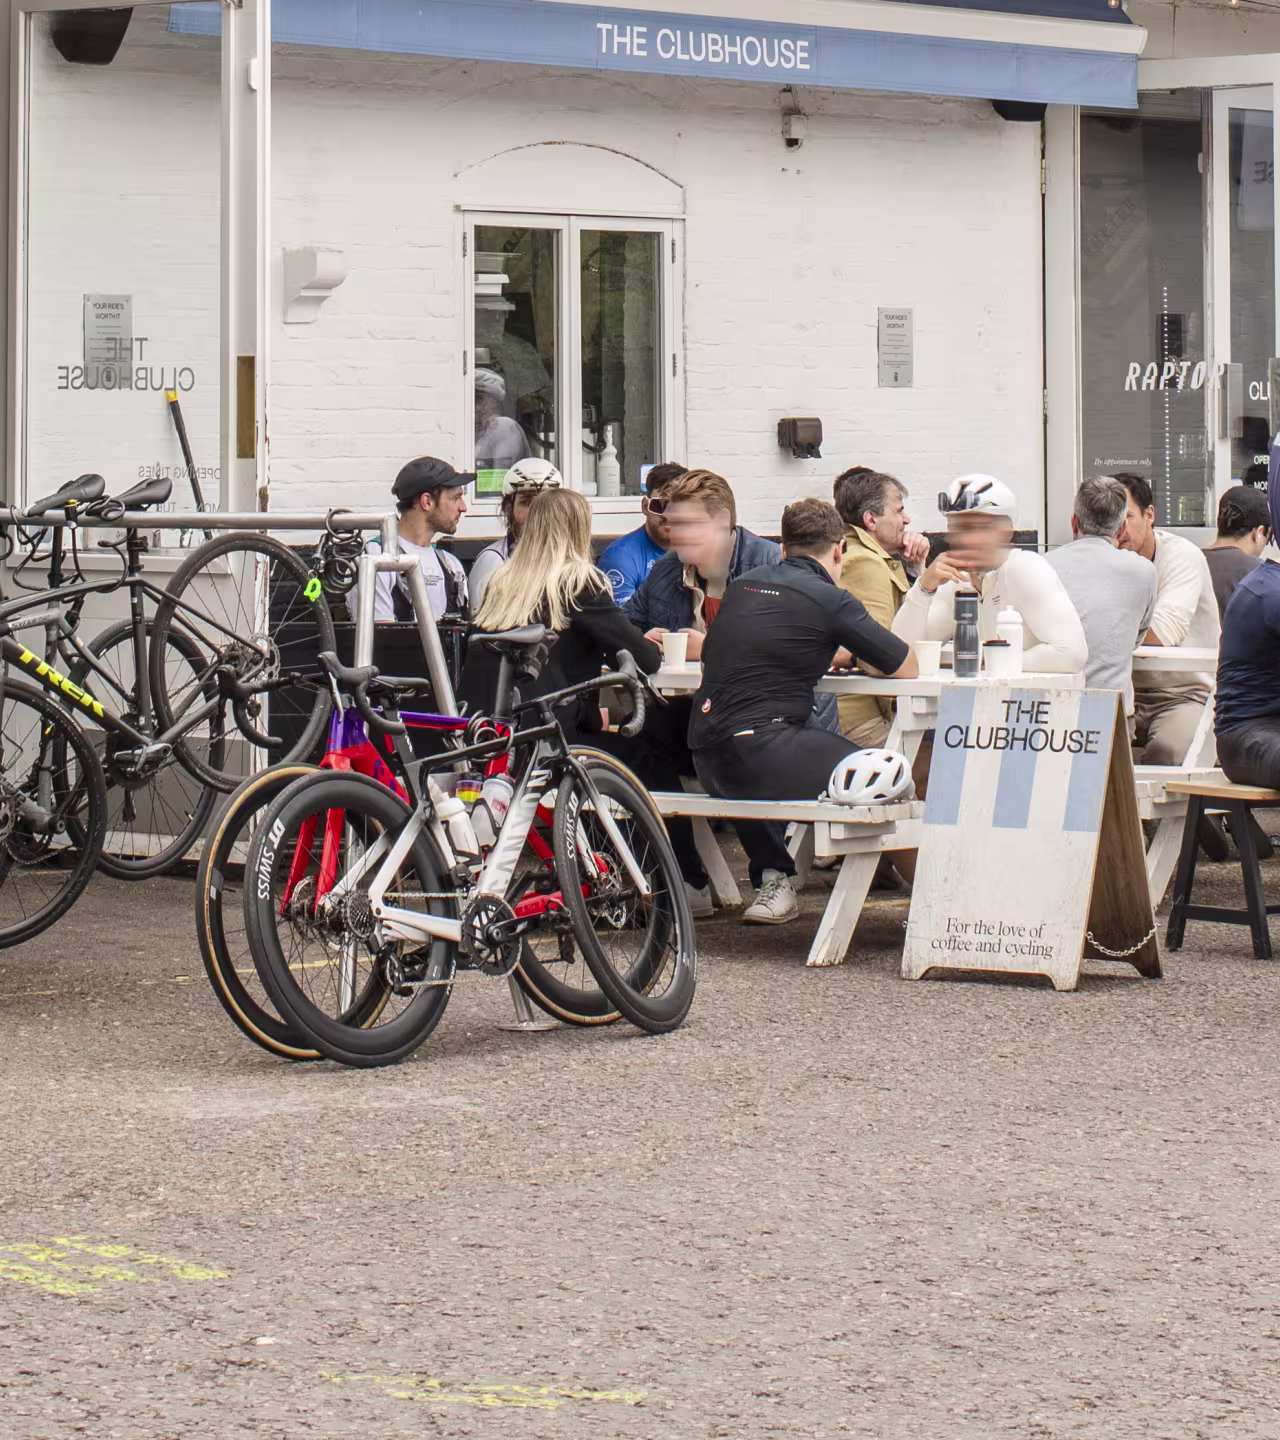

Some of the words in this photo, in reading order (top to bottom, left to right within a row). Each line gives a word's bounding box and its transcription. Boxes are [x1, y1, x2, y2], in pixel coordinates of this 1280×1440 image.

[597, 23, 648, 56] THE
[656, 28, 811, 69] CLUBHOUSE
[16, 643, 105, 717] TREK
[1002, 700, 1051, 724] THE
[944, 725, 1101, 754] CLUBHOUSE
[268, 817, 286, 849] DT
[566, 814, 576, 861] SWISS
[257, 846, 275, 900] SWISS
[946, 917, 971, 934] For
[974, 919, 995, 936] the
[998, 920, 1025, 938] love
[1029, 922, 1047, 939] of
[931, 934, 973, 952] coffee
[975, 937, 1001, 954] and
[1005, 941, 1054, 960] cycling
